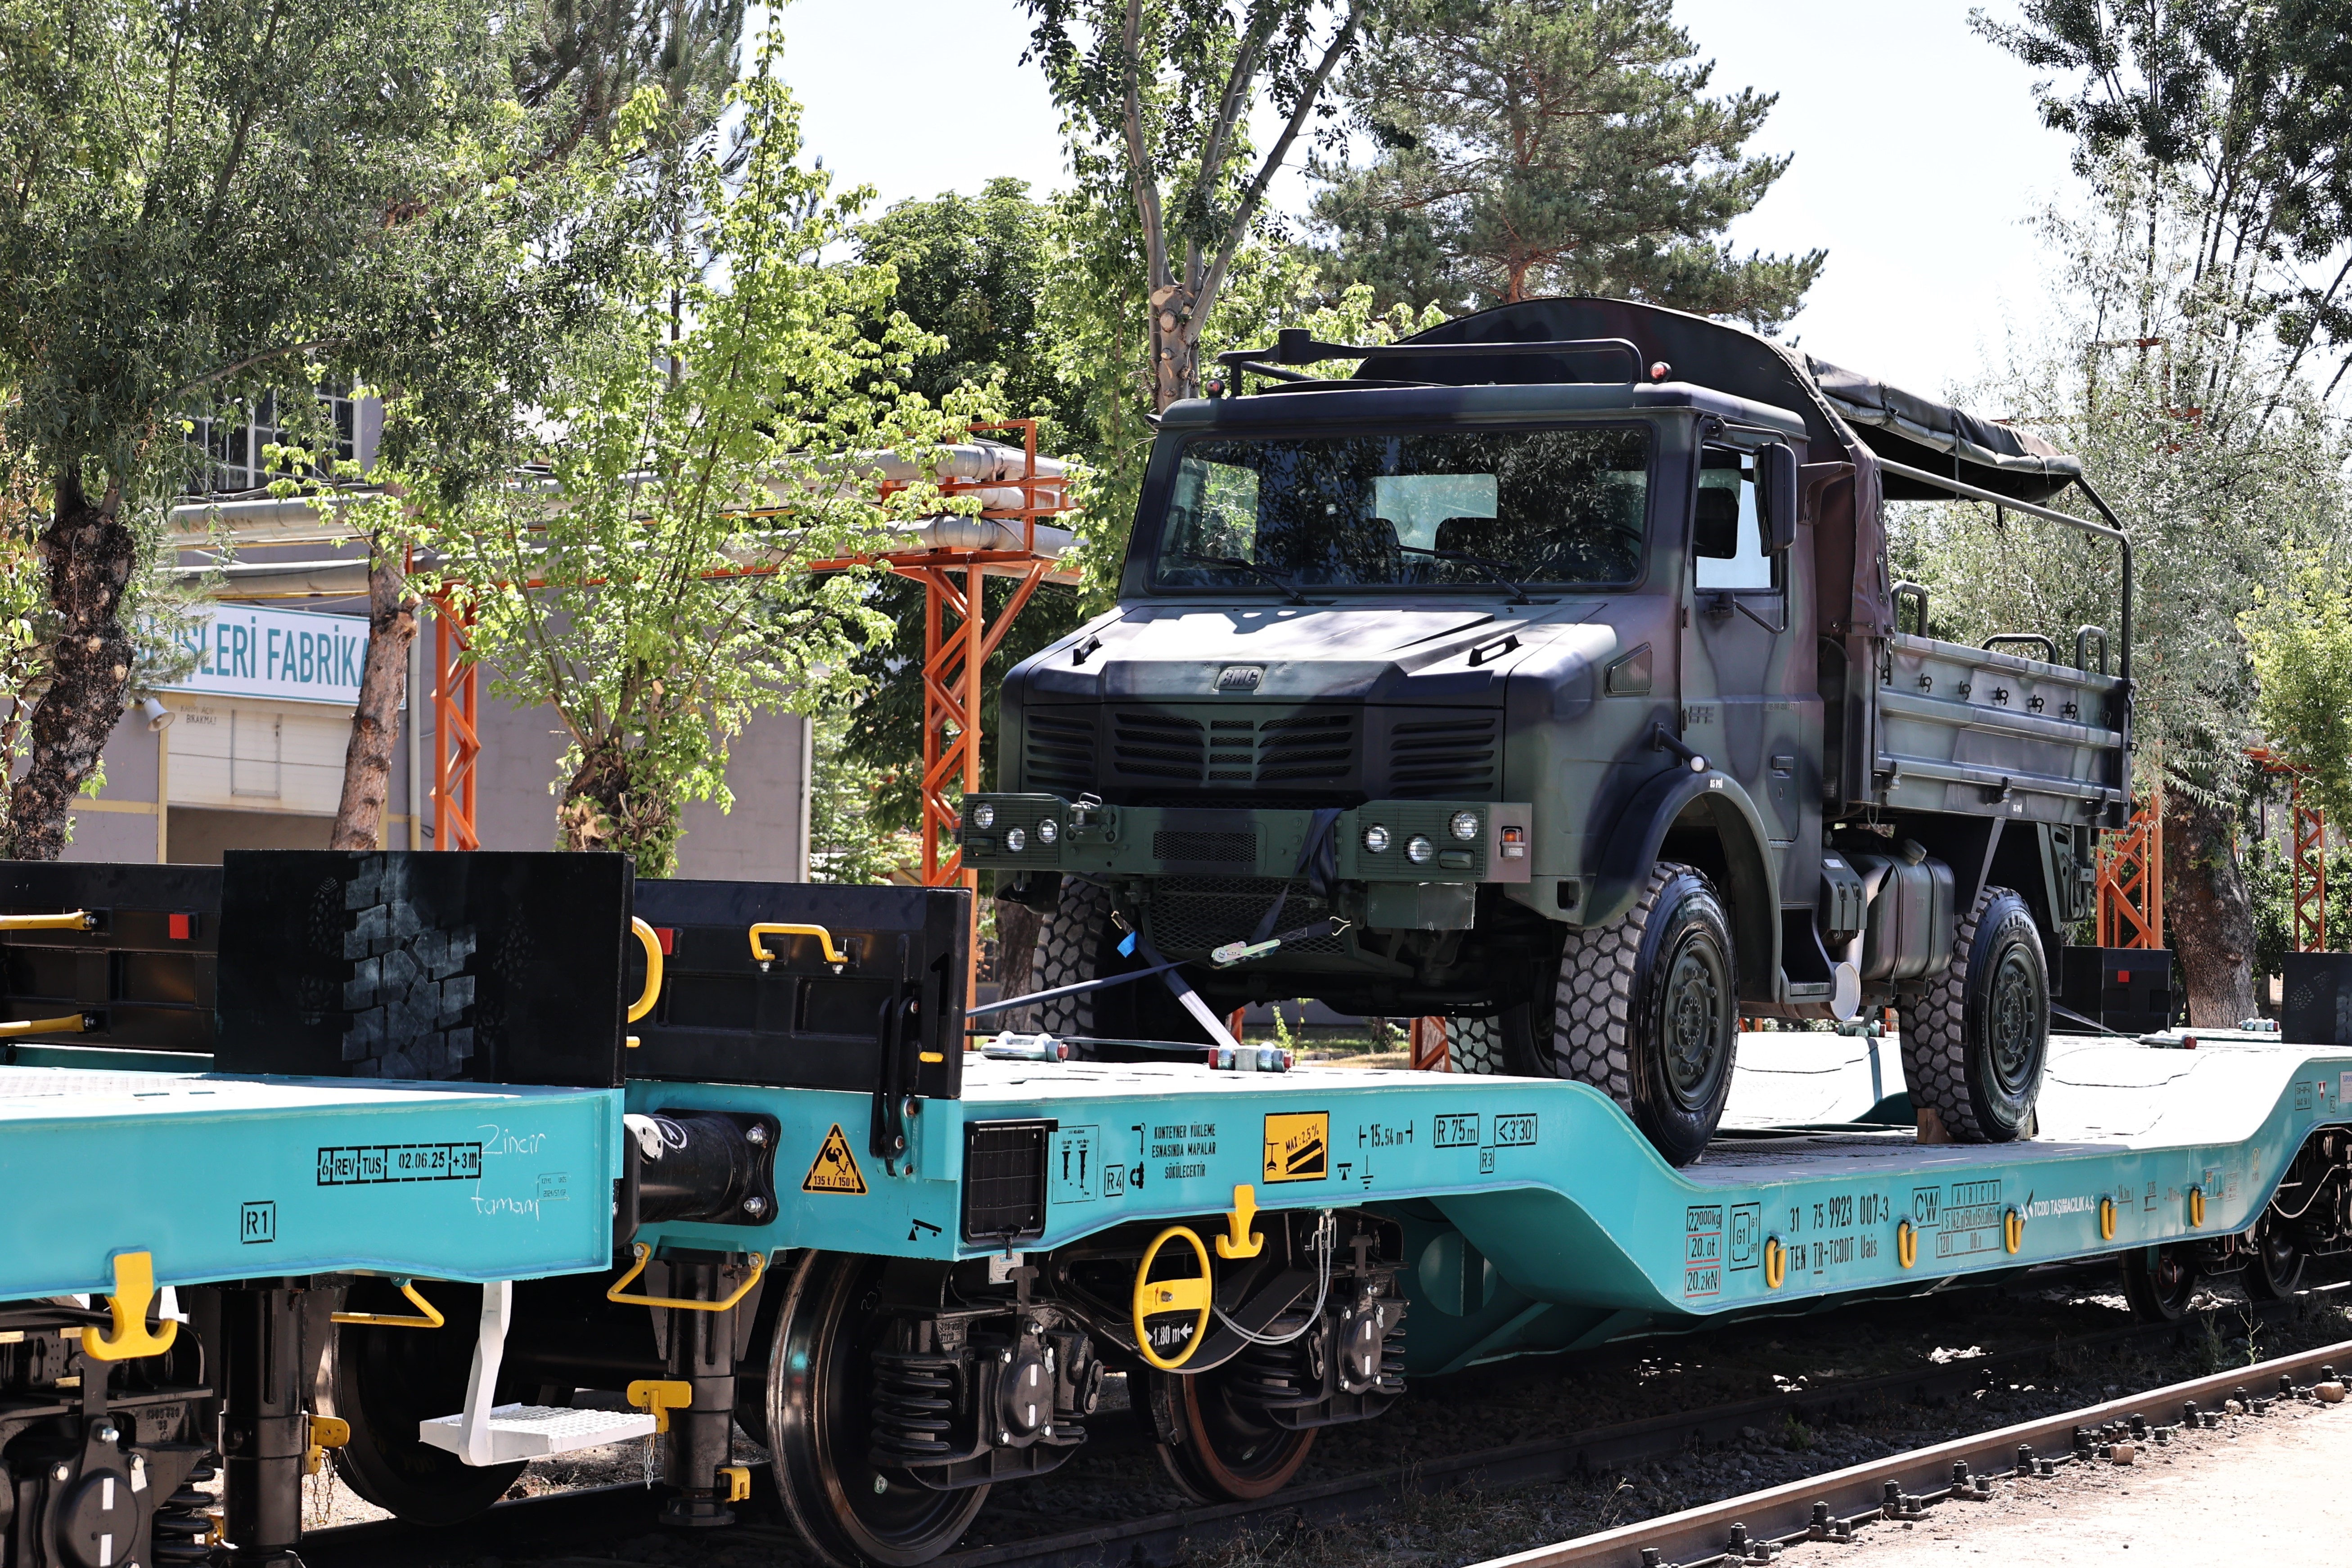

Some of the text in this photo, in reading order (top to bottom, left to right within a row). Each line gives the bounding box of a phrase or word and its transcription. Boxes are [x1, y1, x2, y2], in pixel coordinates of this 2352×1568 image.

[1220, 669, 1258, 685] BMC
[1154, 1121, 1216, 1140] KONTEYNER YÜKLEME
[1152, 1142, 1216, 1158] ESNASINDA MAPALAR
[1482, 1152, 1492, 1167] R3
[322, 1158, 329, 1176] 6
[335, 1158, 355, 1176] REV
[363, 1157, 381, 1174] TUS
[399, 1151, 445, 1169] 02.06.25
[1165, 1161, 1205, 1179] SÖKÜLECEKTİR
[814, 1175, 825, 1185] 135
[827, 1176, 830, 1185] t
[838, 1176, 850, 1187] 150
[852, 1177, 855, 1187] t
[1107, 1171, 1122, 1190] R4
[1956, 1184, 1996, 1205] A B C D
[1790, 1194, 1889, 1232] 31 75 9923 007-3
[1915, 1192, 1938, 1222] CW
[2034, 1194, 2095, 1218] TCDD TAŞIMACILIK A.Ş.
[1751, 1217, 1757, 1227] G1
[1946, 1212, 1949, 1229] S
[1737, 1228, 1745, 1245] G1
[1940, 1235, 1949, 1253] 120
[1790, 1233, 1877, 1271] TEN TR-TCDDT Uais
[1687, 1271, 1717, 1291] 20.2kN
[1153, 1325, 1180, 1346] 1.80 m
